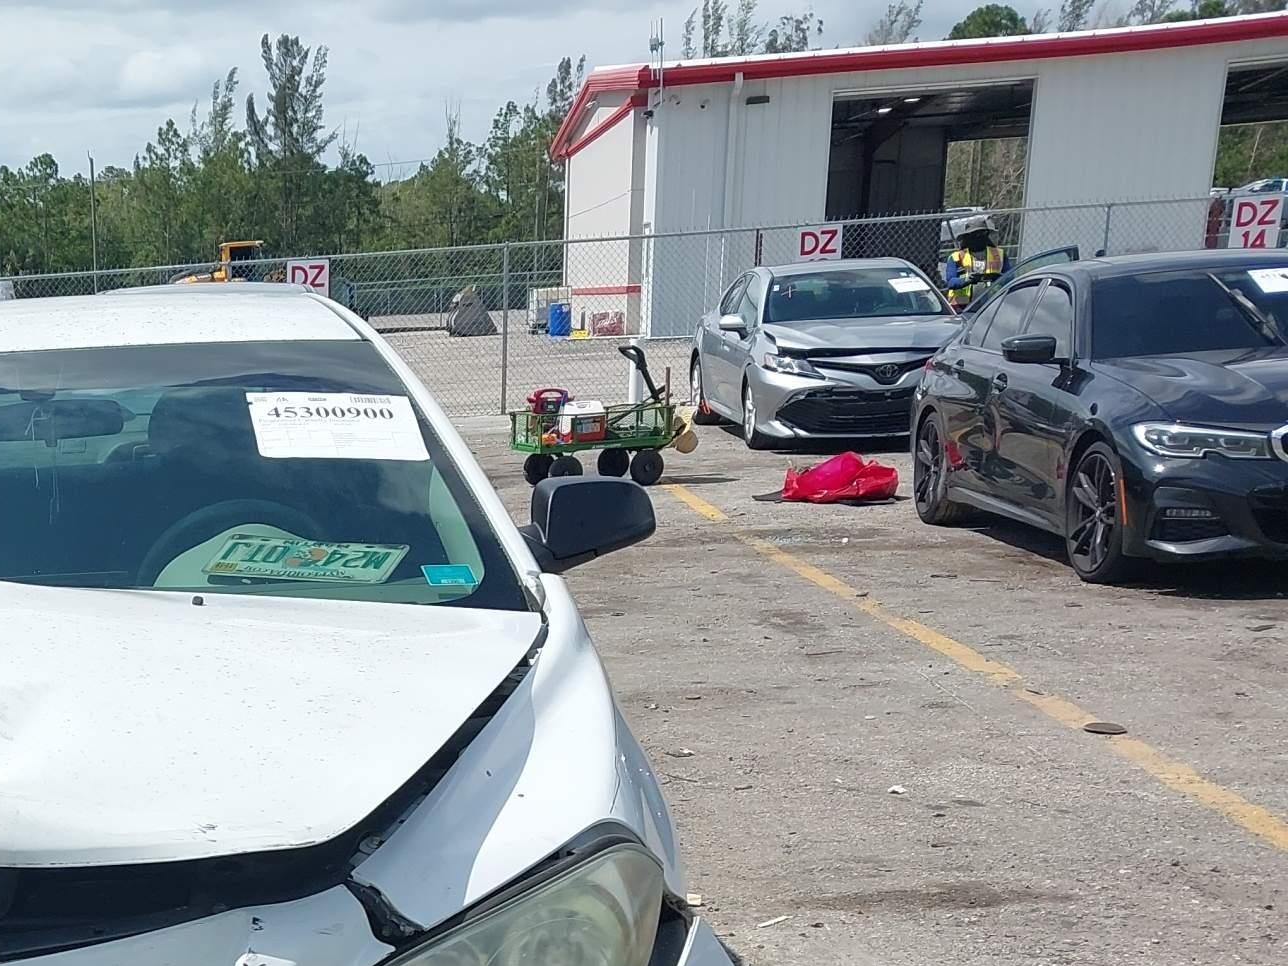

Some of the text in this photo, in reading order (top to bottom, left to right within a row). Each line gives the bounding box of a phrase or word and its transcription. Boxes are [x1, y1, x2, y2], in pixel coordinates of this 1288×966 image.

[1236, 199, 1279, 227] DZ
[800, 229, 838, 256] DZ
[1242, 229, 1266, 248] 14
[291, 264, 325, 288] DZ
[266, 405, 394, 420] 45300900
[321, 549, 392, 570] M24
